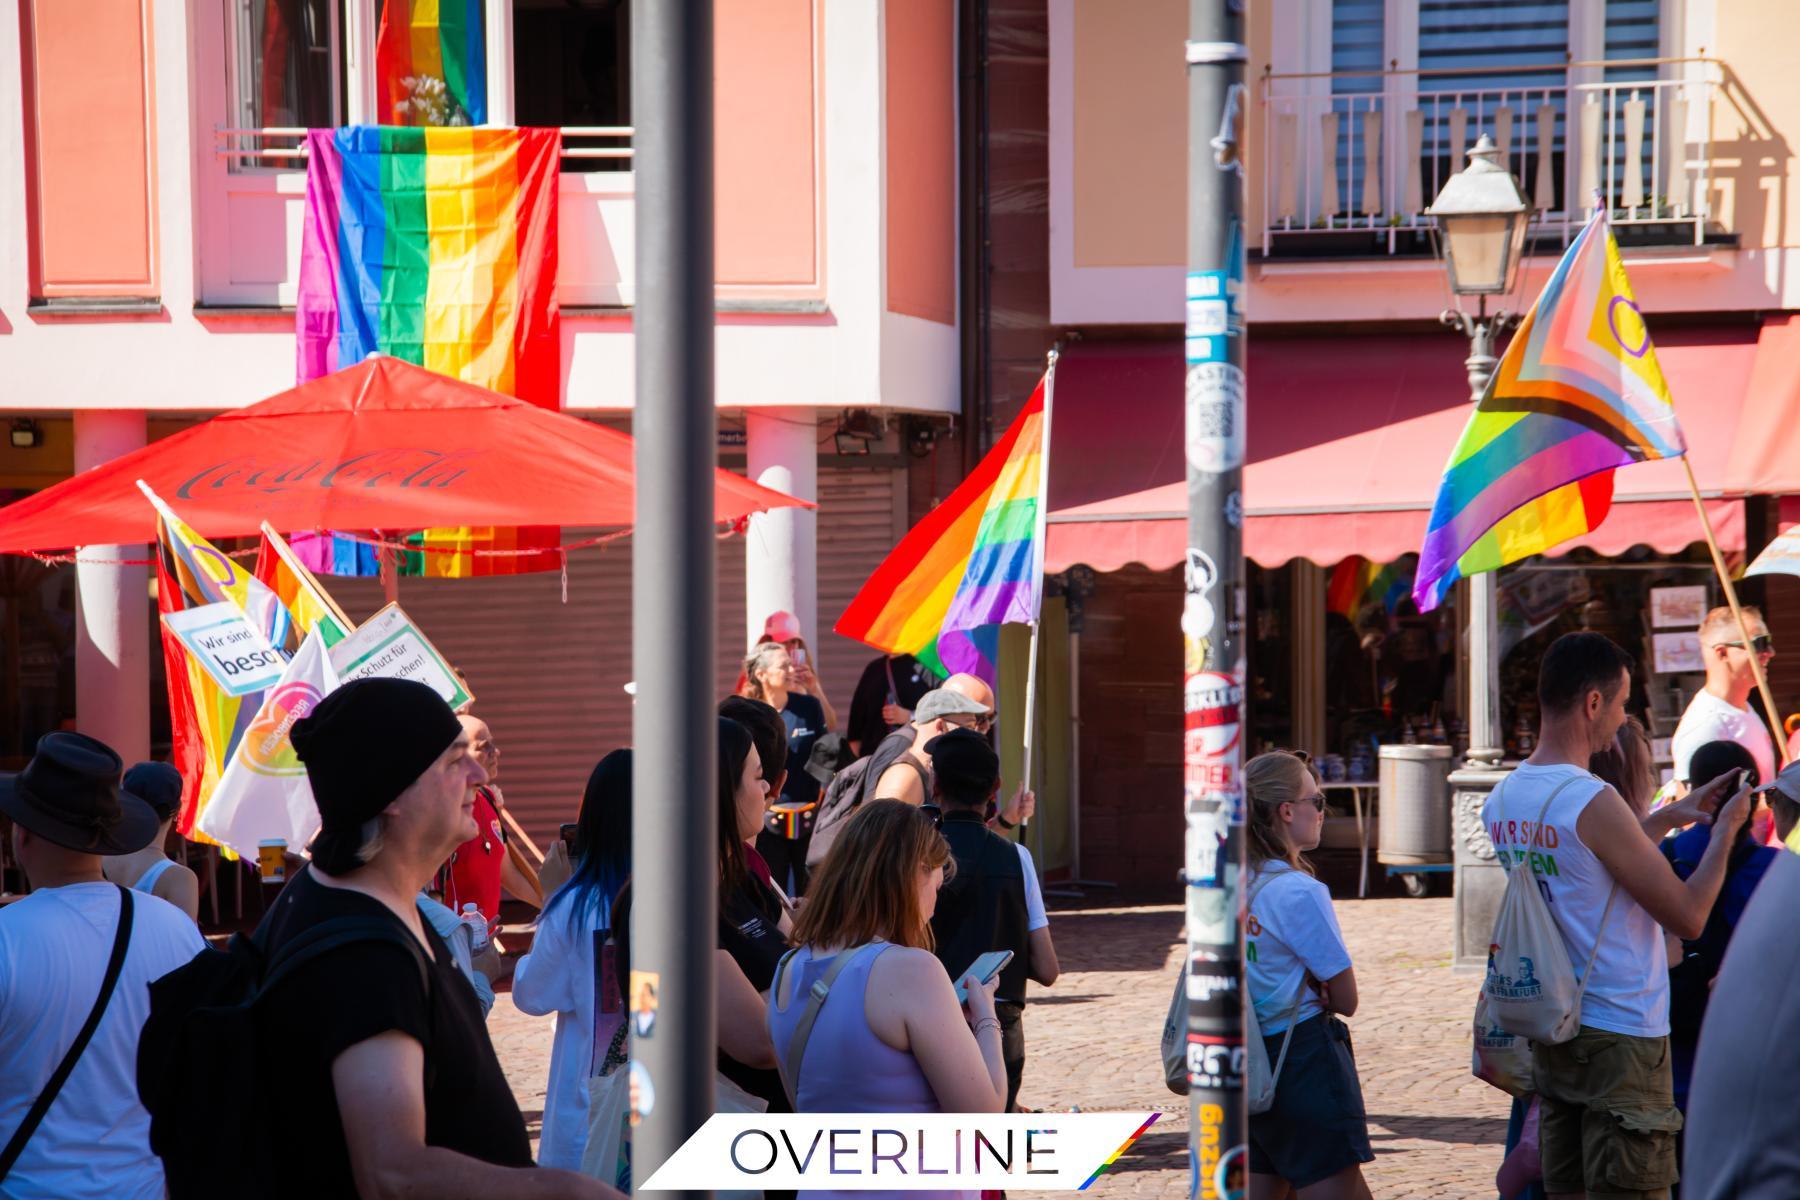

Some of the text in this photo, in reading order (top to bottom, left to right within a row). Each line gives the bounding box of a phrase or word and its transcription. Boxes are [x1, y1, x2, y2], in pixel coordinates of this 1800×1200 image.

[199, 628, 254, 650] Wir sind
[212, 648, 295, 677] beso
[360, 652, 394, 679] Schutz
[390, 643, 408, 664] für
